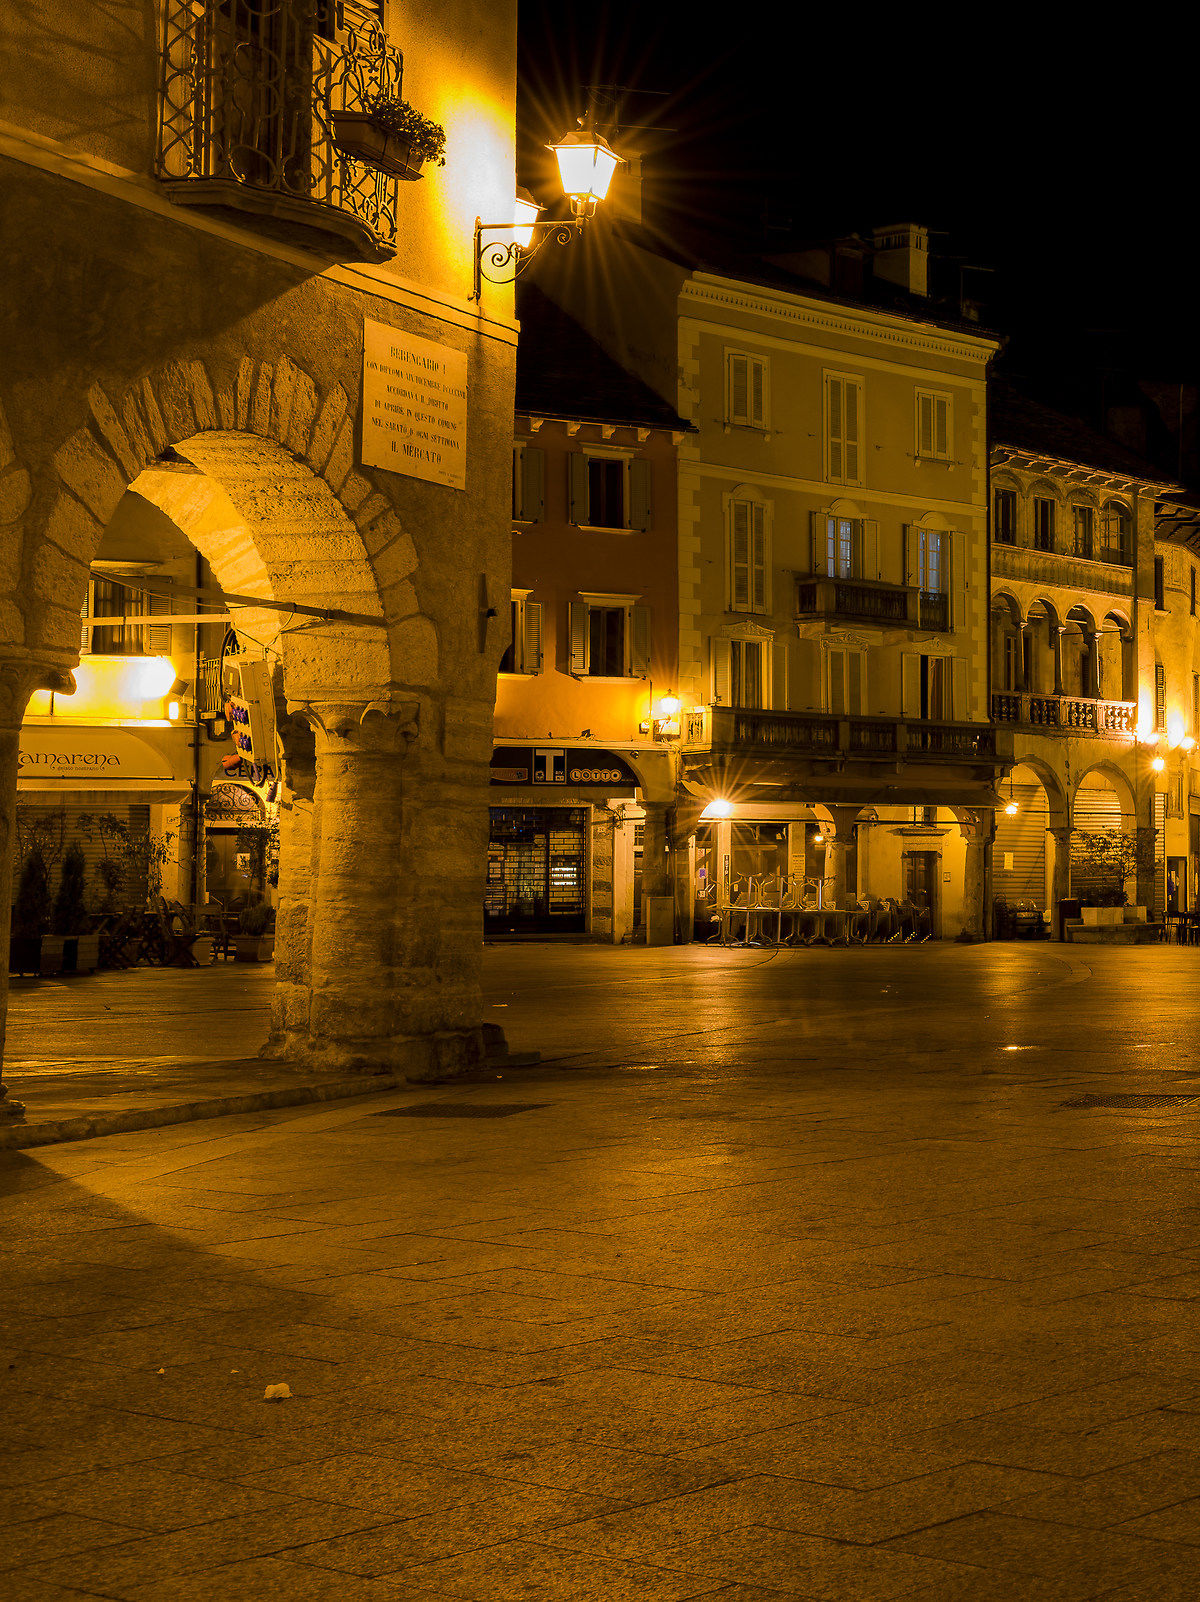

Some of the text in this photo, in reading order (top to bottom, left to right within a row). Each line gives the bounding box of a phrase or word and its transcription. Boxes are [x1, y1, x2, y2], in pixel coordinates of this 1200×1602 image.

[390, 346, 438, 372] BERENGARIO
[385, 420, 407, 434] SABATO
[415, 411, 435, 426] QUESTO
[391, 440, 441, 465] IL MERCATO
[18, 750, 121, 769] amarena
[570, 769, 622, 782] LOTTO
